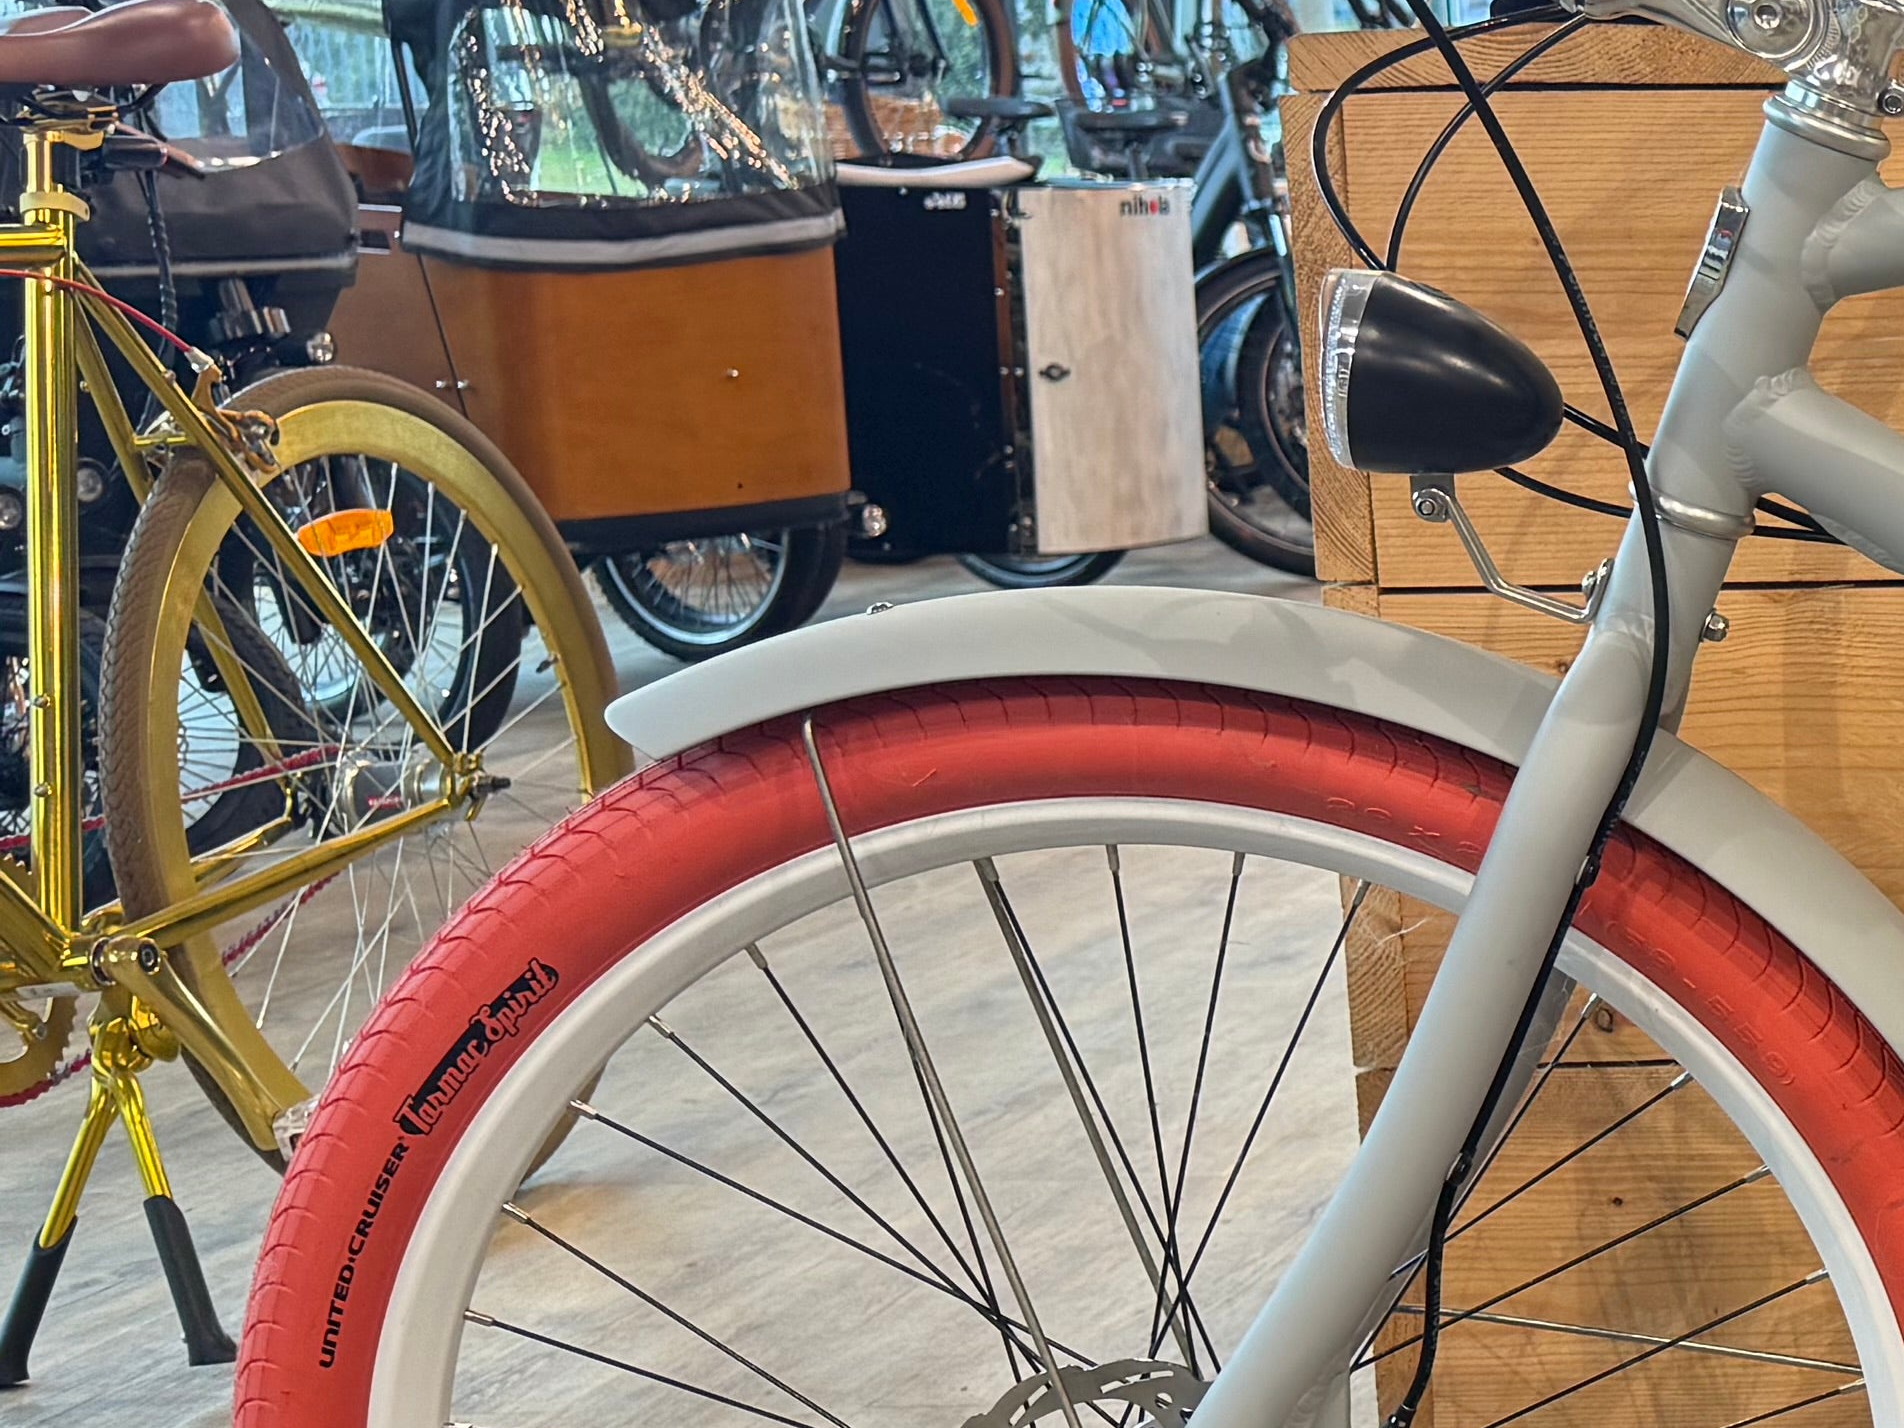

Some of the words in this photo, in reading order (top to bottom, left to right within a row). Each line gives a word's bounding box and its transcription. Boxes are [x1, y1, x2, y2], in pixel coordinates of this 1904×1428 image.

[1119, 194, 1170, 217] nihola
[392, 1036, 490, 1138] Tarmac
[470, 957, 561, 1047] Spirit
